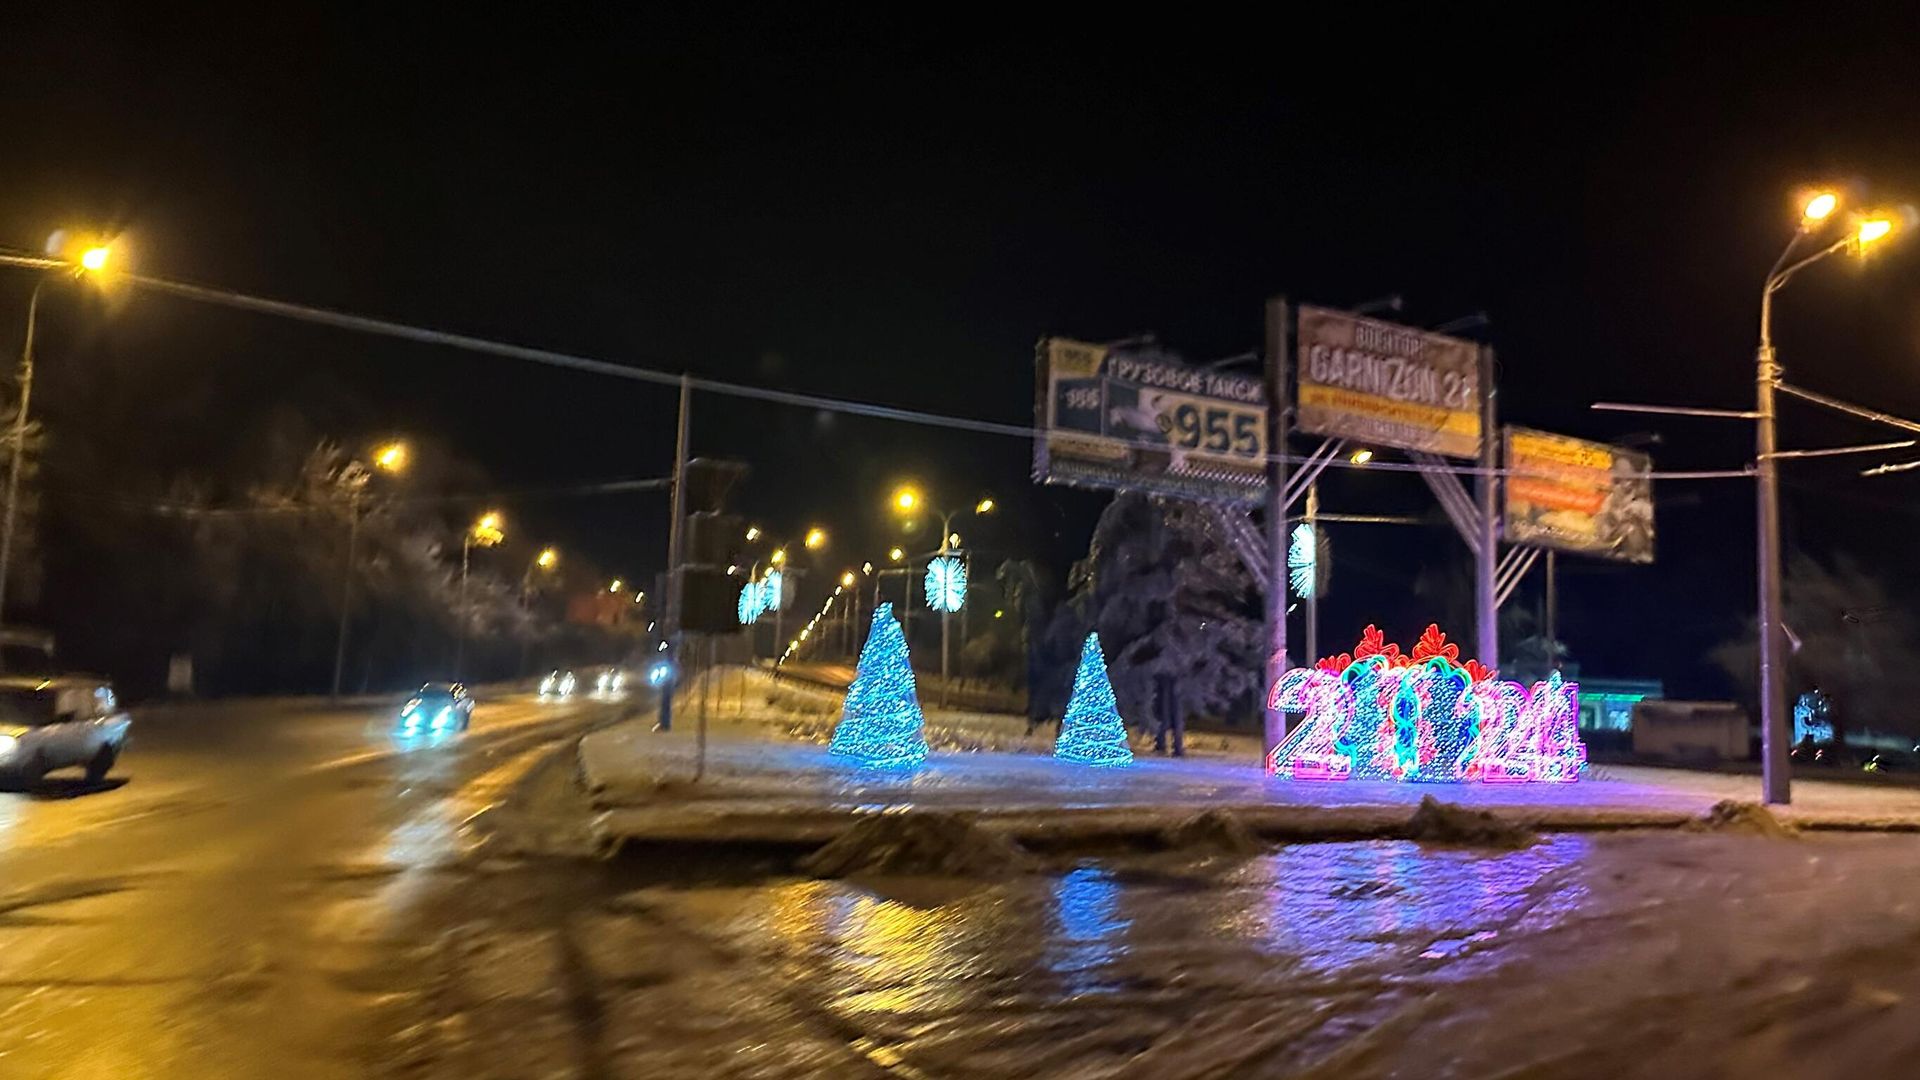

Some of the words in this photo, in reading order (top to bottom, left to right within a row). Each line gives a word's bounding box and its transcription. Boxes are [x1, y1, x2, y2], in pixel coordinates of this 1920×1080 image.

[1108, 357, 1203, 392] ГРУЗОВОЕ
[1205, 374, 1264, 402] ТАКСИ
[1310, 344, 1438, 404] GARNIZON
[1175, 404, 1259, 459] 955
[1266, 664, 1586, 783] 2024
